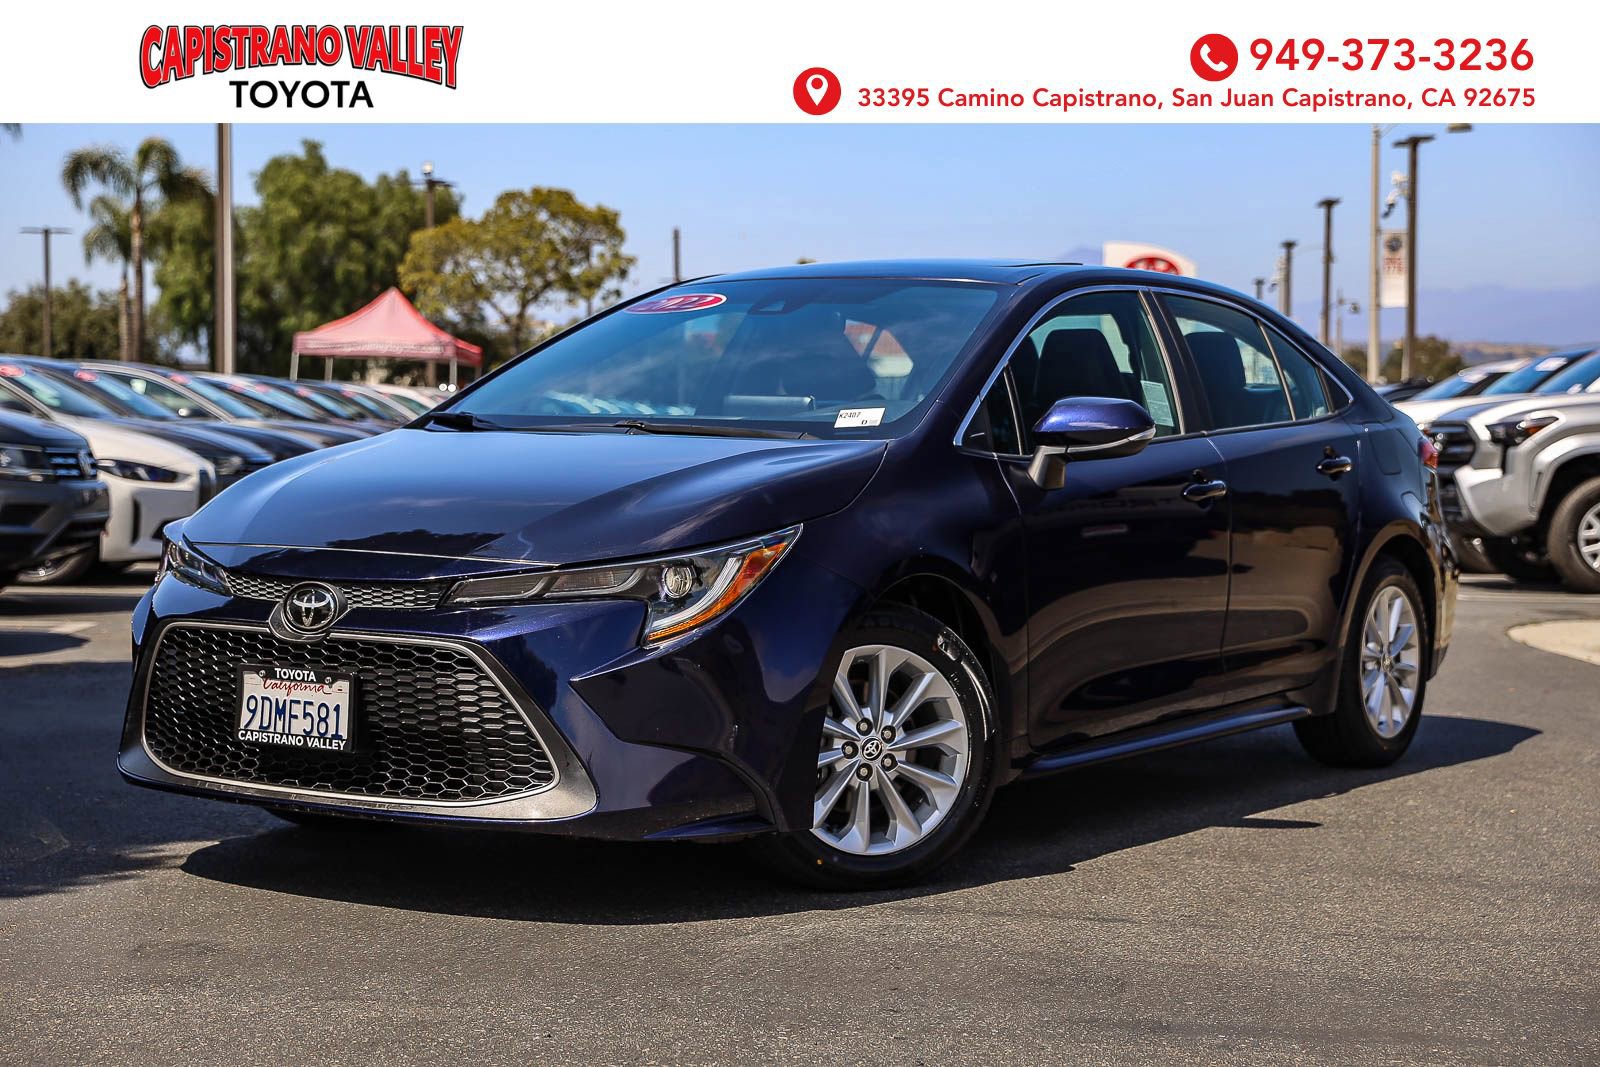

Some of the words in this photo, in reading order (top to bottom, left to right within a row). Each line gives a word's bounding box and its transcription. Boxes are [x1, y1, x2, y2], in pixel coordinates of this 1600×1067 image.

[274, 668, 316, 682] TOYOTA
[243, 694, 343, 739] 9DMF581
[238, 730, 304, 746] CAPISTRANO
[306, 736, 346, 751] VALLEY
